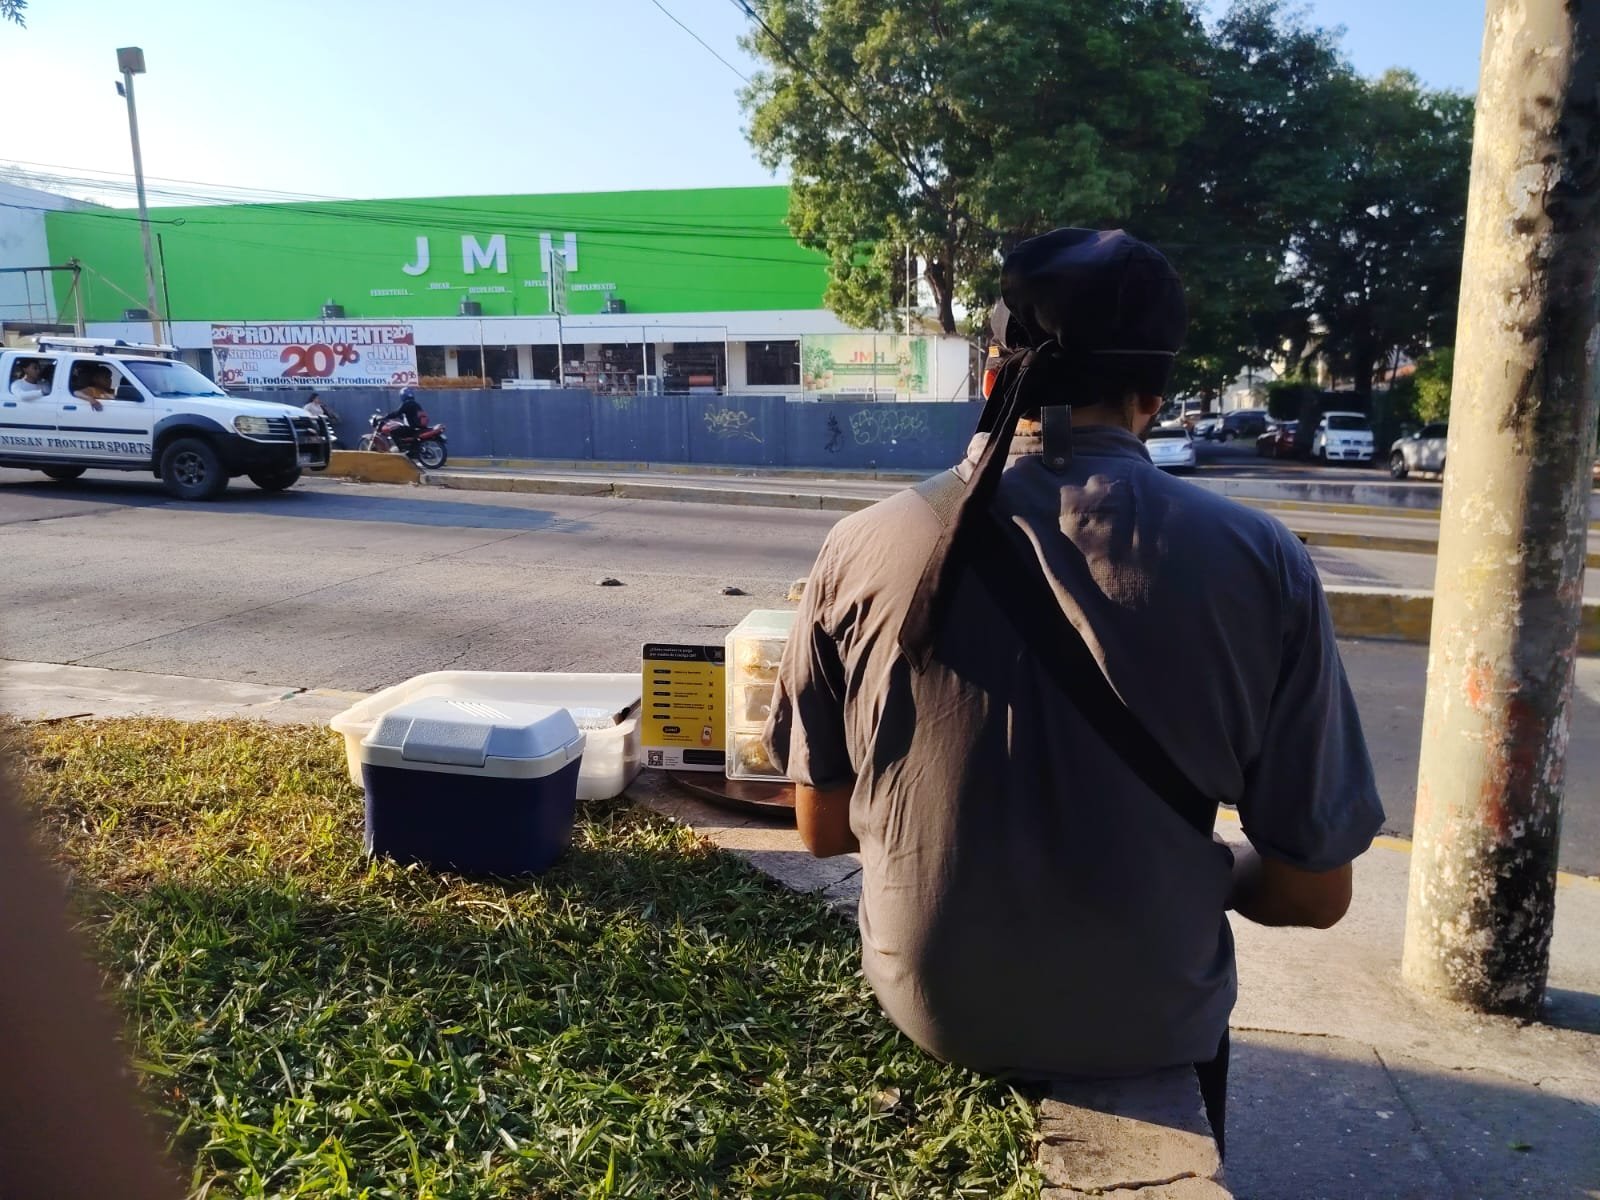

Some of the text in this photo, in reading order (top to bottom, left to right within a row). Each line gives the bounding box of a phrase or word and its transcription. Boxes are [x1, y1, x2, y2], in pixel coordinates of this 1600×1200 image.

[232, 325, 394, 344] PROXIMAMENTE
[279, 342, 361, 378] 20%
[368, 344, 409, 361] JMH
[849, 351, 885, 363] JMH
[391, 371, 416, 385] 20%
[1, 435, 43, 446] NISSAN
